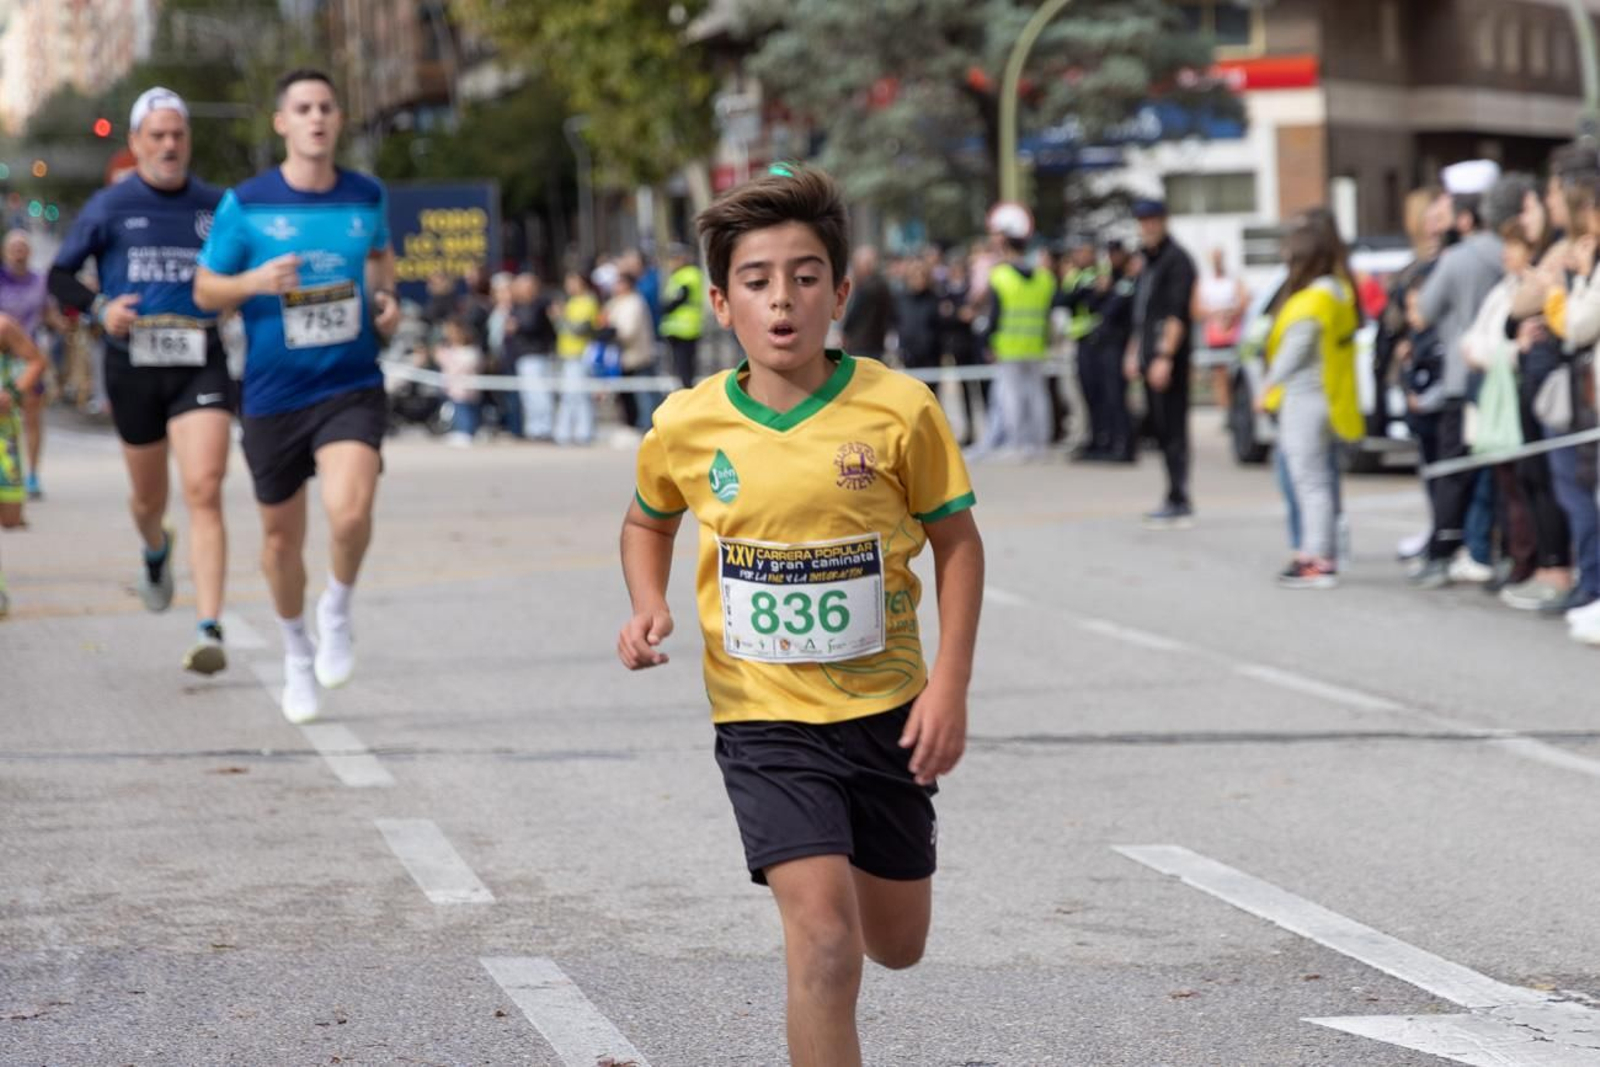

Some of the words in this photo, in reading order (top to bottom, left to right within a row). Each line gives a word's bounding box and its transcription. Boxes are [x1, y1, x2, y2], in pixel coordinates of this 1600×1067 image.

[420, 208, 487, 232] TODO
[404, 234, 434, 256] LO
[442, 233, 487, 257] QUE
[304, 306, 346, 331] 752
[726, 544, 755, 568] XXV
[756, 549, 812, 561] CARRERA
[815, 542, 873, 559] POPULAR
[770, 559, 804, 572] gran
[811, 551, 874, 569] caminata
[755, 571, 767, 582] LA
[793, 572, 807, 583] LA
[750, 589, 850, 635] 836
